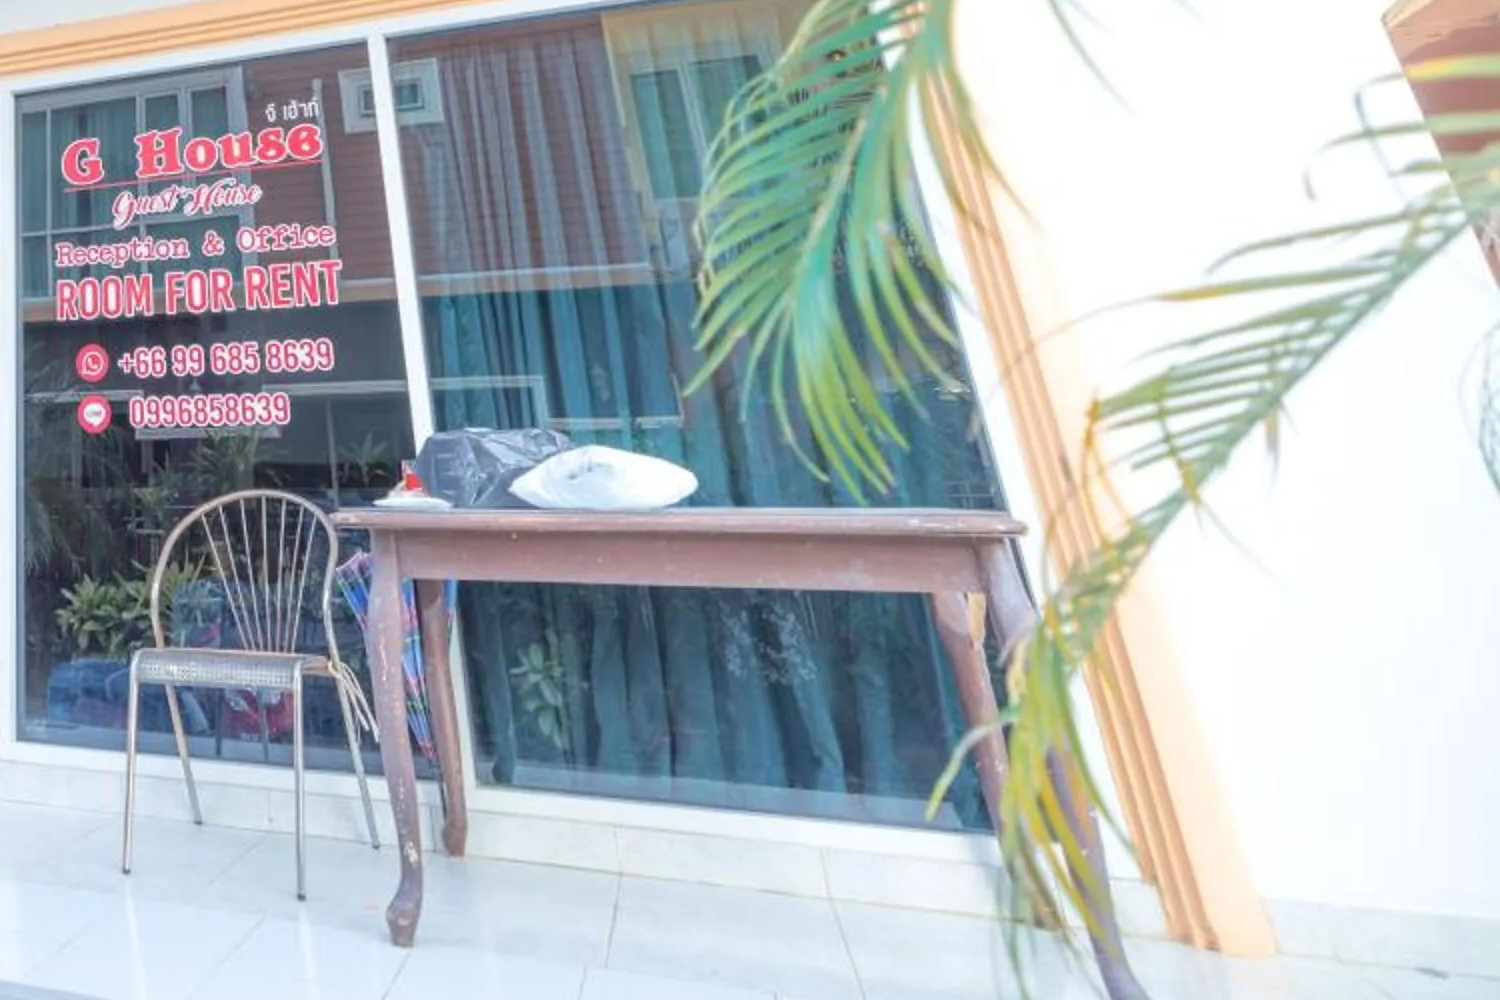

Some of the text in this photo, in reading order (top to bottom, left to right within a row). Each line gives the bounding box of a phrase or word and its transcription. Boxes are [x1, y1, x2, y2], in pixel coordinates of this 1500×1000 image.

[61, 138, 104, 187] G
[112, 184, 179, 231] Guest
[55, 223, 336, 268] Reception & Office
[56, 260, 342, 321] ROOM FOR RENT
[117, 338, 334, 378] +66 99 685 8639
[129, 393, 291, 428] 0996858639
